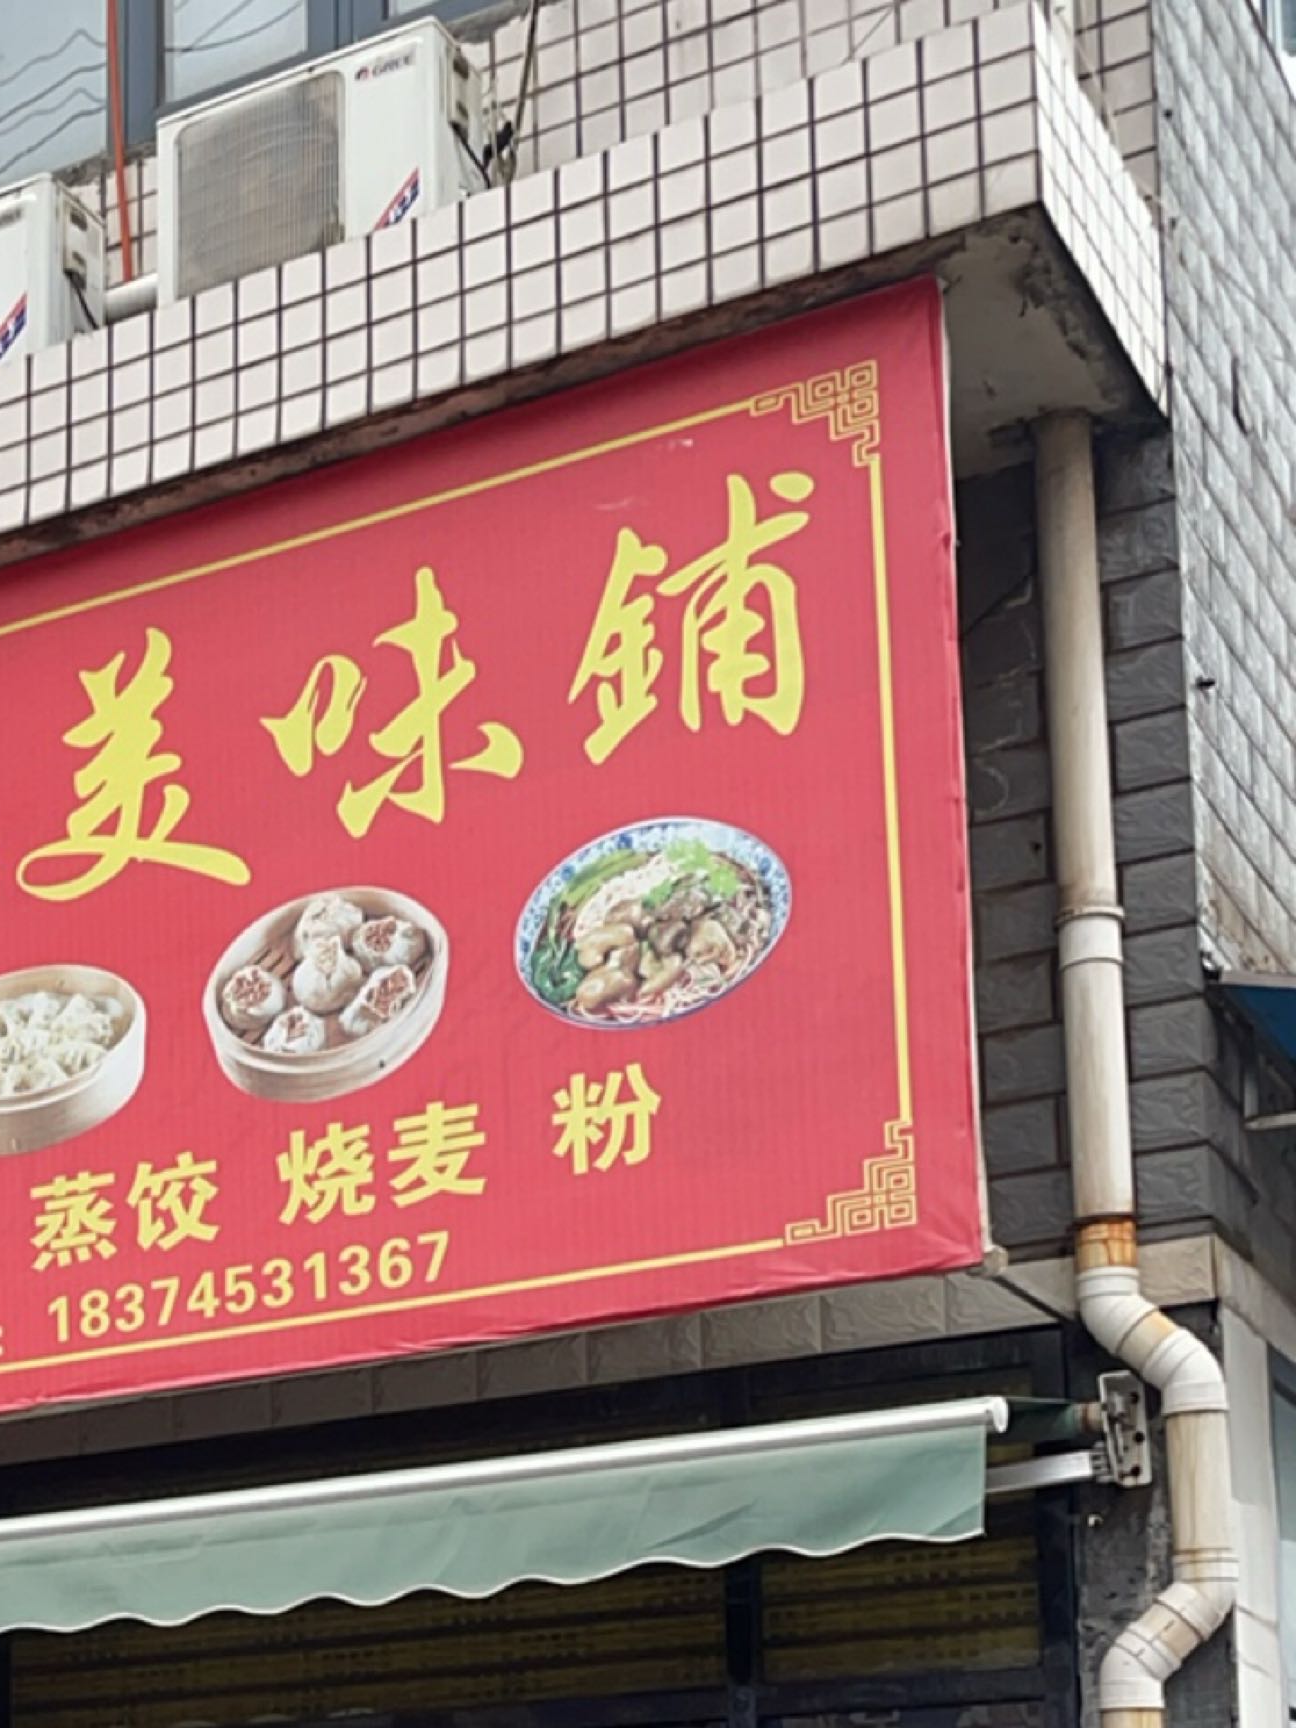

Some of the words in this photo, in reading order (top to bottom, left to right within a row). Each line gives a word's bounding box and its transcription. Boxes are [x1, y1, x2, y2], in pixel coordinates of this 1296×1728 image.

[30, 1151, 220, 1270] 蒸饺
[276, 1101, 486, 1225] 烧麦
[552, 1063, 661, 1175] 粉
[48, 1230, 450, 1342] 18374531367
